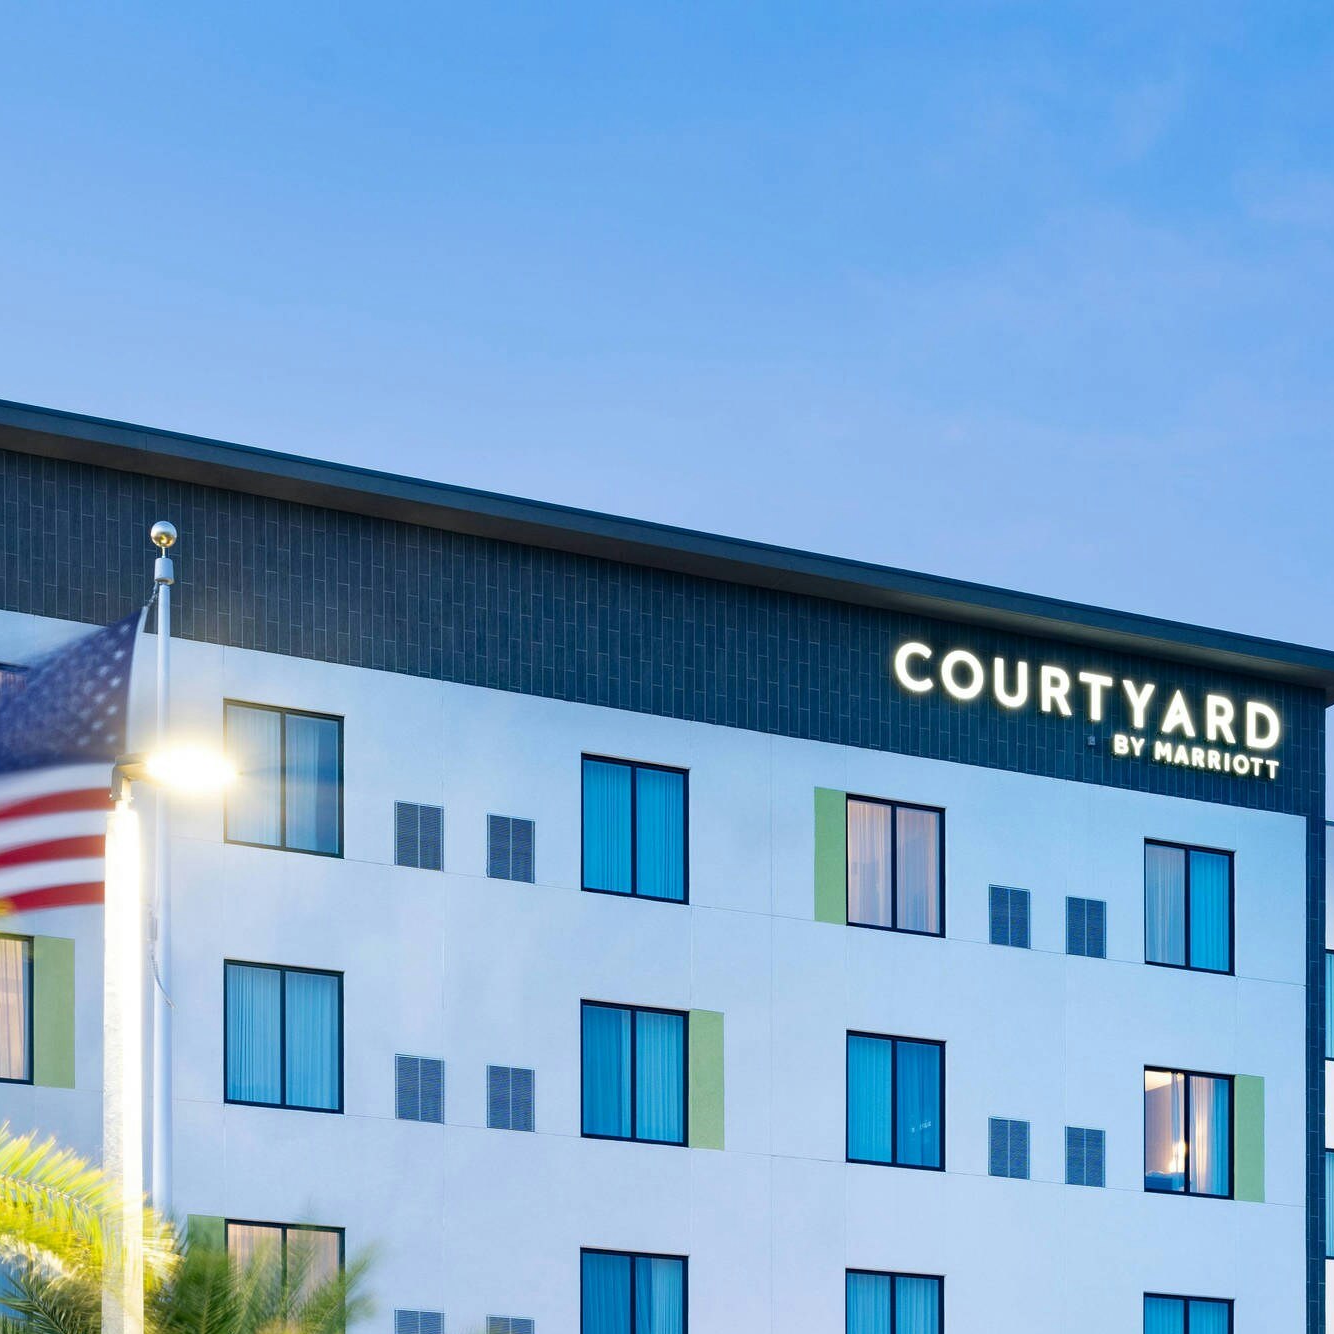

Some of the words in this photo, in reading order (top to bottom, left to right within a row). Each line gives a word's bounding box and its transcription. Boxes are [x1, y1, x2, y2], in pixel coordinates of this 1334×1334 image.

[894, 642, 1281, 750] COURTYARD
[1113, 734, 1146, 756] BY
[1154, 741, 1280, 779] MARRIOTT
